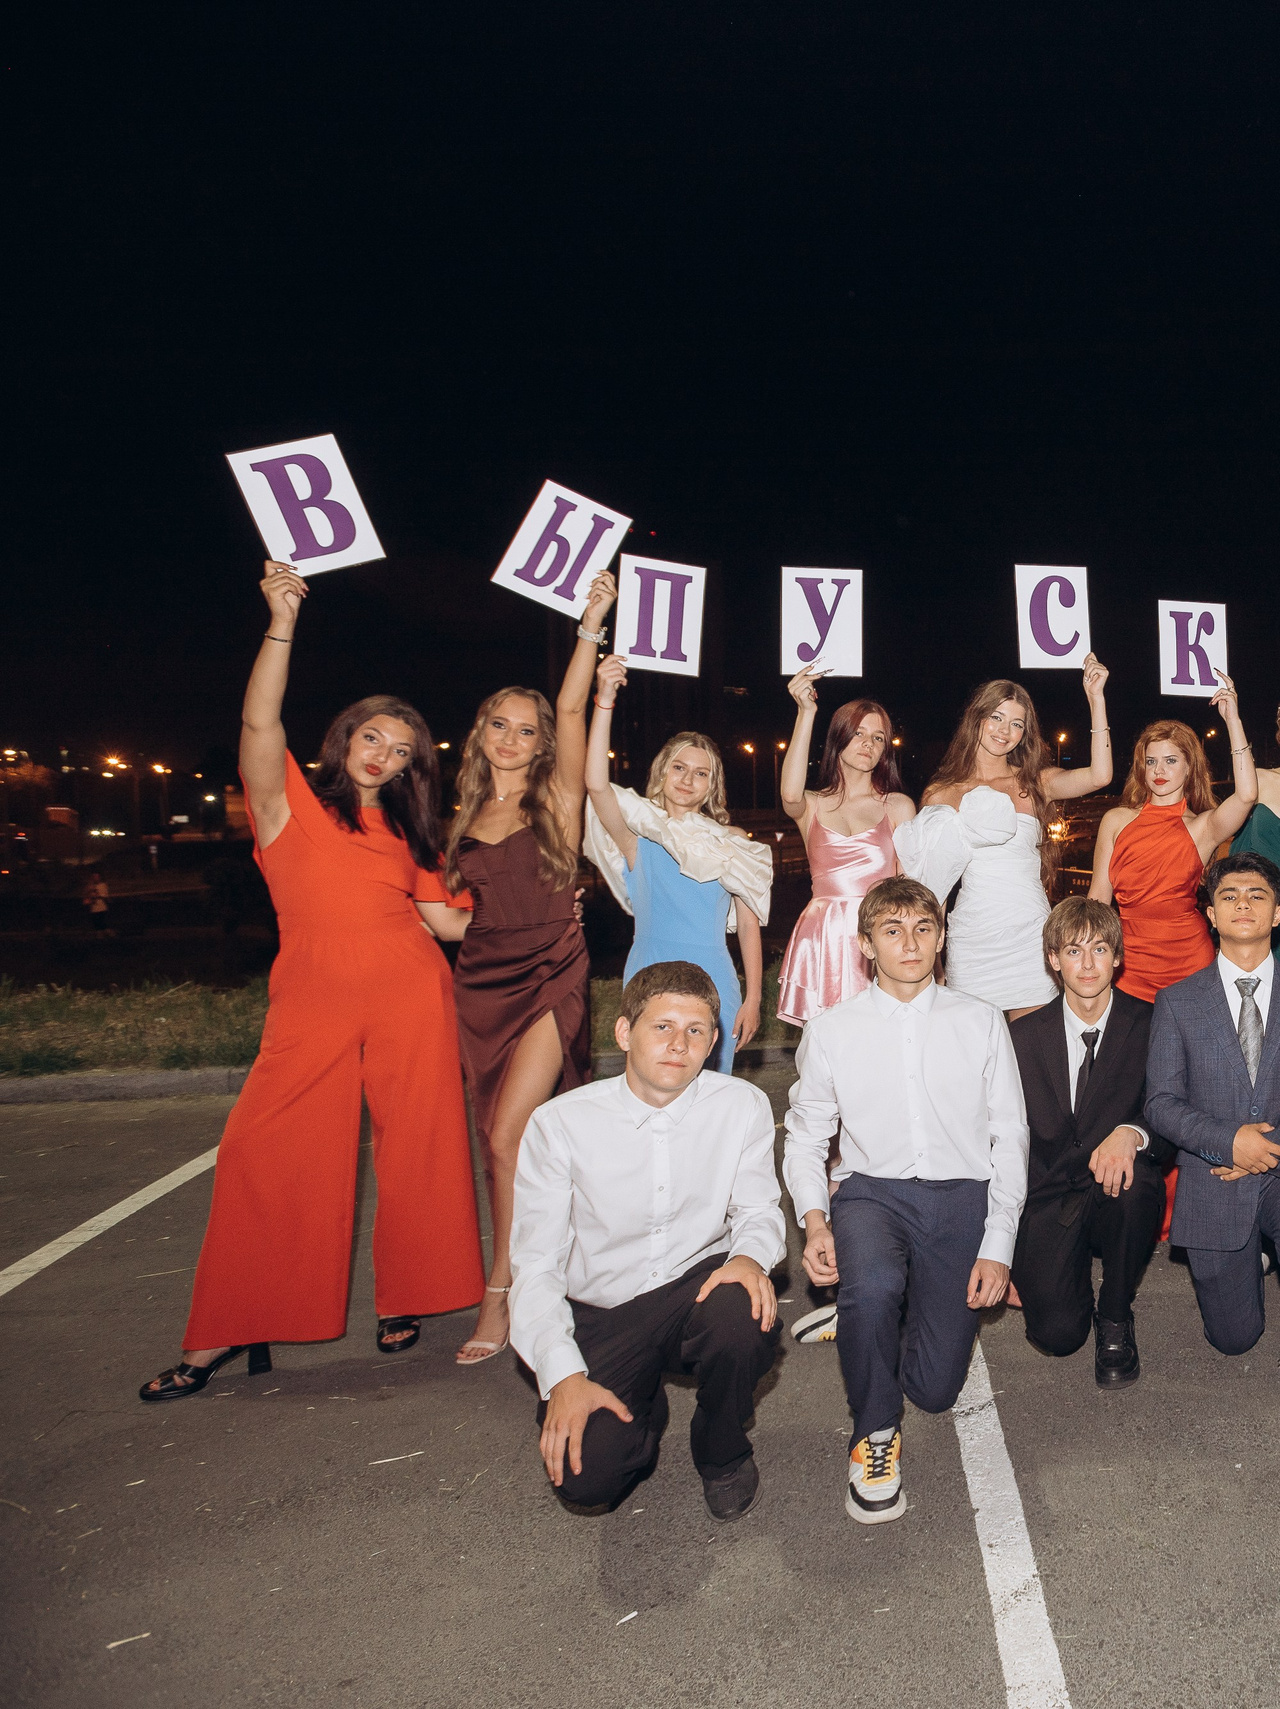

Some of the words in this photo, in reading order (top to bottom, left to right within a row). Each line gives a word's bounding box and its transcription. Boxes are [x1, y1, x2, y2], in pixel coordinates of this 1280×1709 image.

[249, 453, 356, 562] В
[513, 495, 615, 601] Ы
[628, 566, 693, 662] П
[795, 577, 852, 662] У
[1029, 574, 1080, 657] С
[1169, 611, 1218, 686] К
